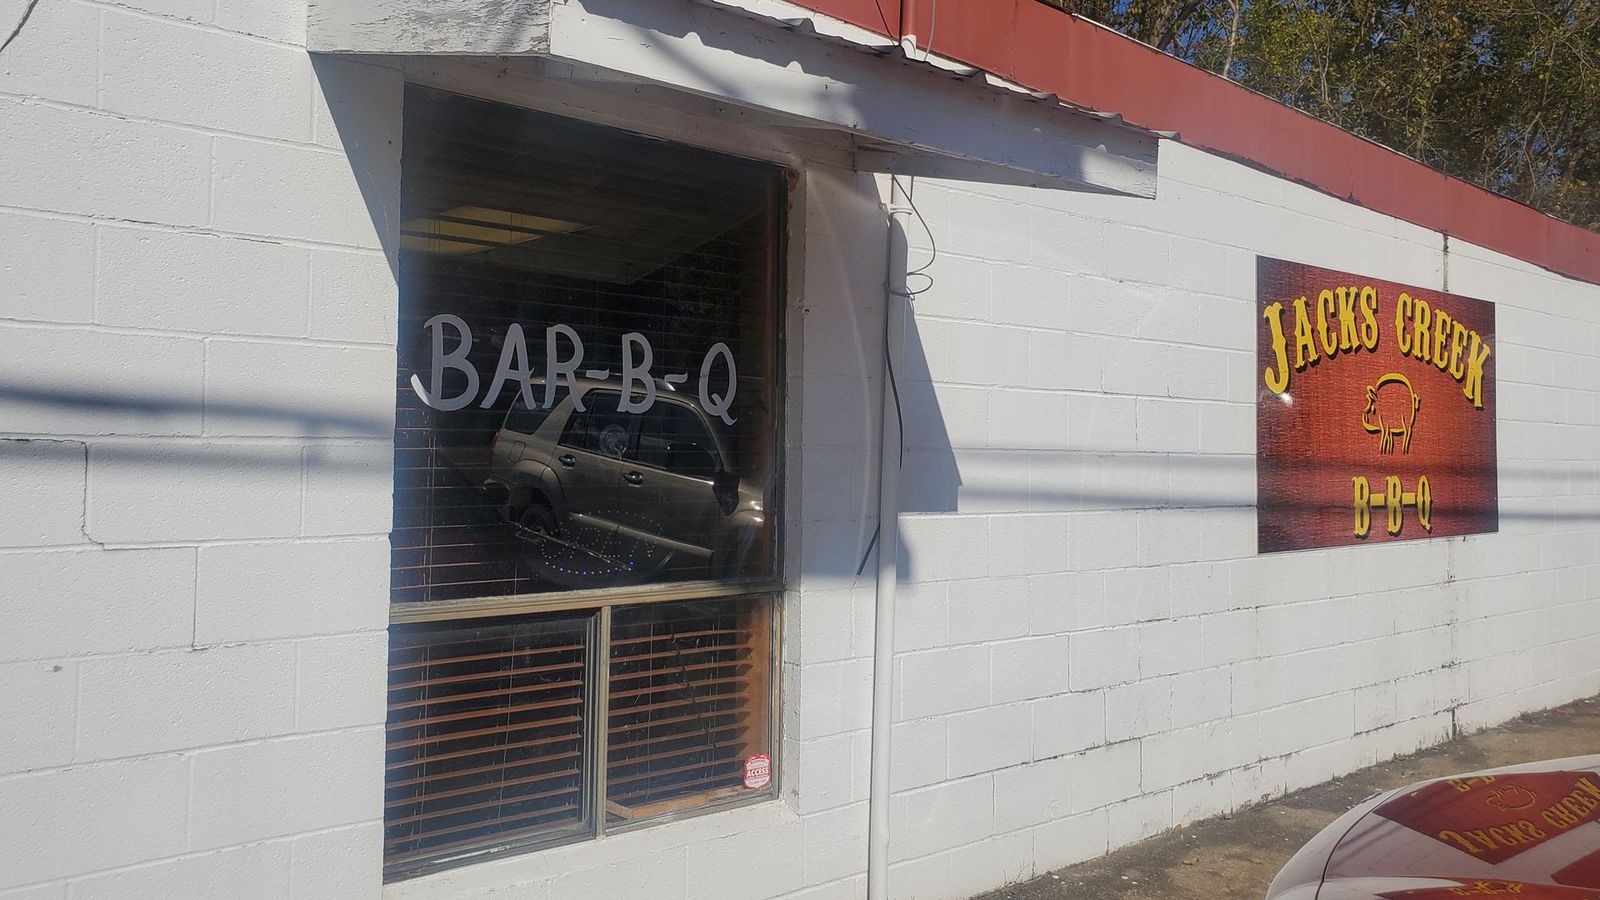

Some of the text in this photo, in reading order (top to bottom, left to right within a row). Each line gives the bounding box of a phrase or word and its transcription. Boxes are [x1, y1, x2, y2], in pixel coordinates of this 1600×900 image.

[410, 313, 738, 426] BAR-B-Q
[1263, 286, 1491, 410] JACKS CREEK
[1352, 474, 1433, 538] B-B-Q
[747, 766, 769, 778] ACCESS
